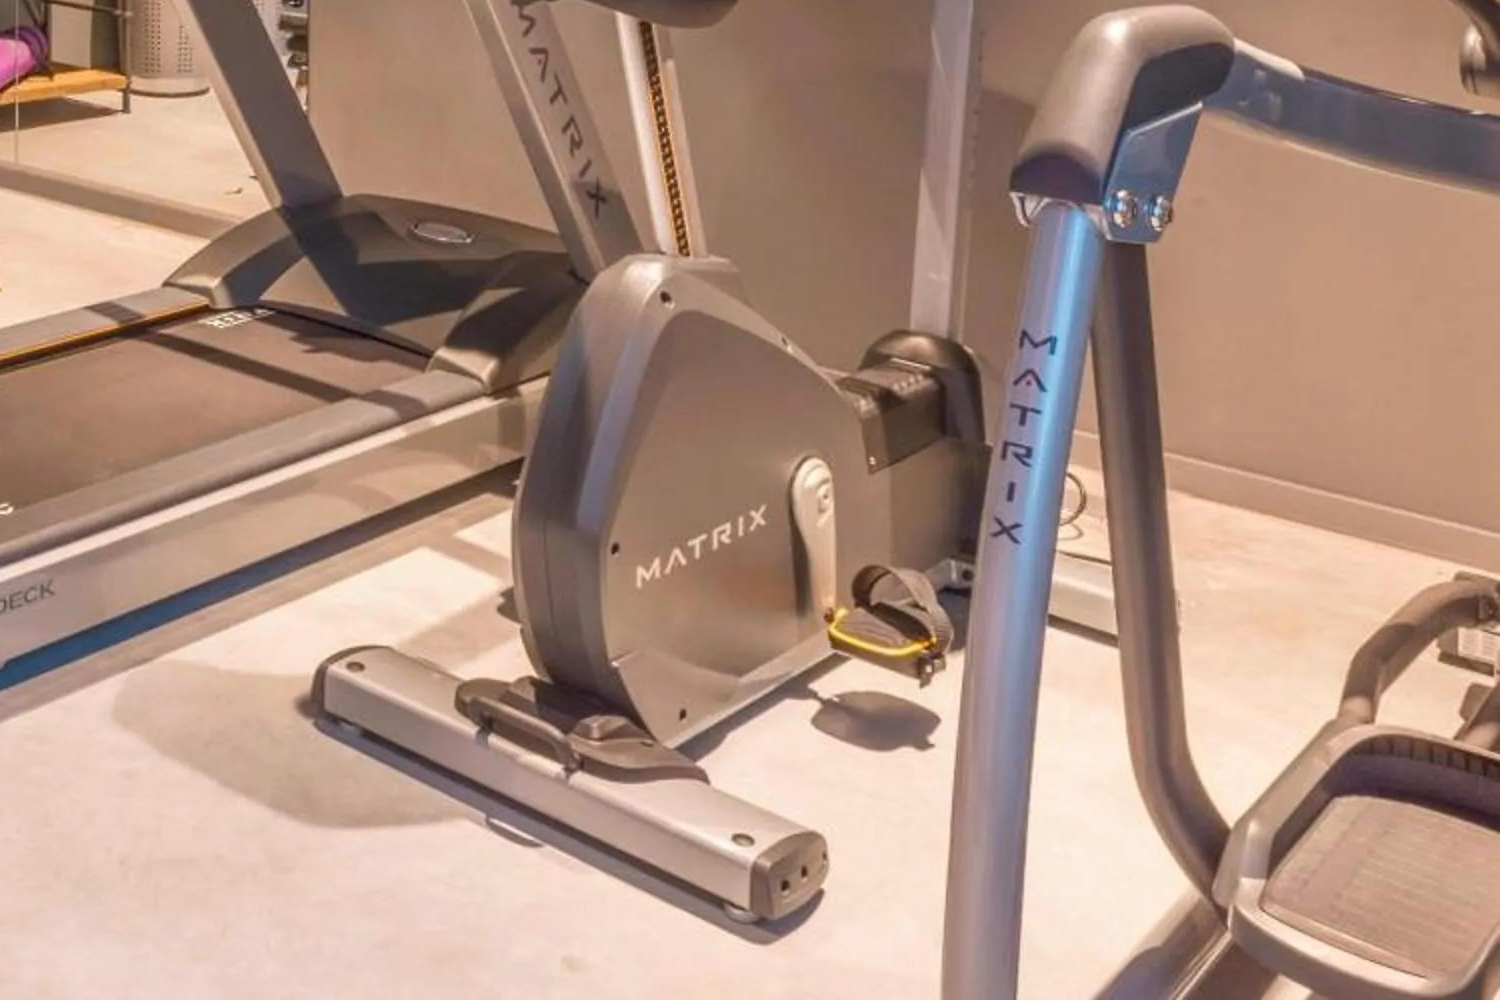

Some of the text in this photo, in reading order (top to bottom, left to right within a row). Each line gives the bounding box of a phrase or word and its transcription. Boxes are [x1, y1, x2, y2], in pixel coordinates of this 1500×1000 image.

[518, 5, 607, 218] MATRIX
[989, 329, 1059, 545] MATRIX
[635, 503, 768, 590] MATRIX
